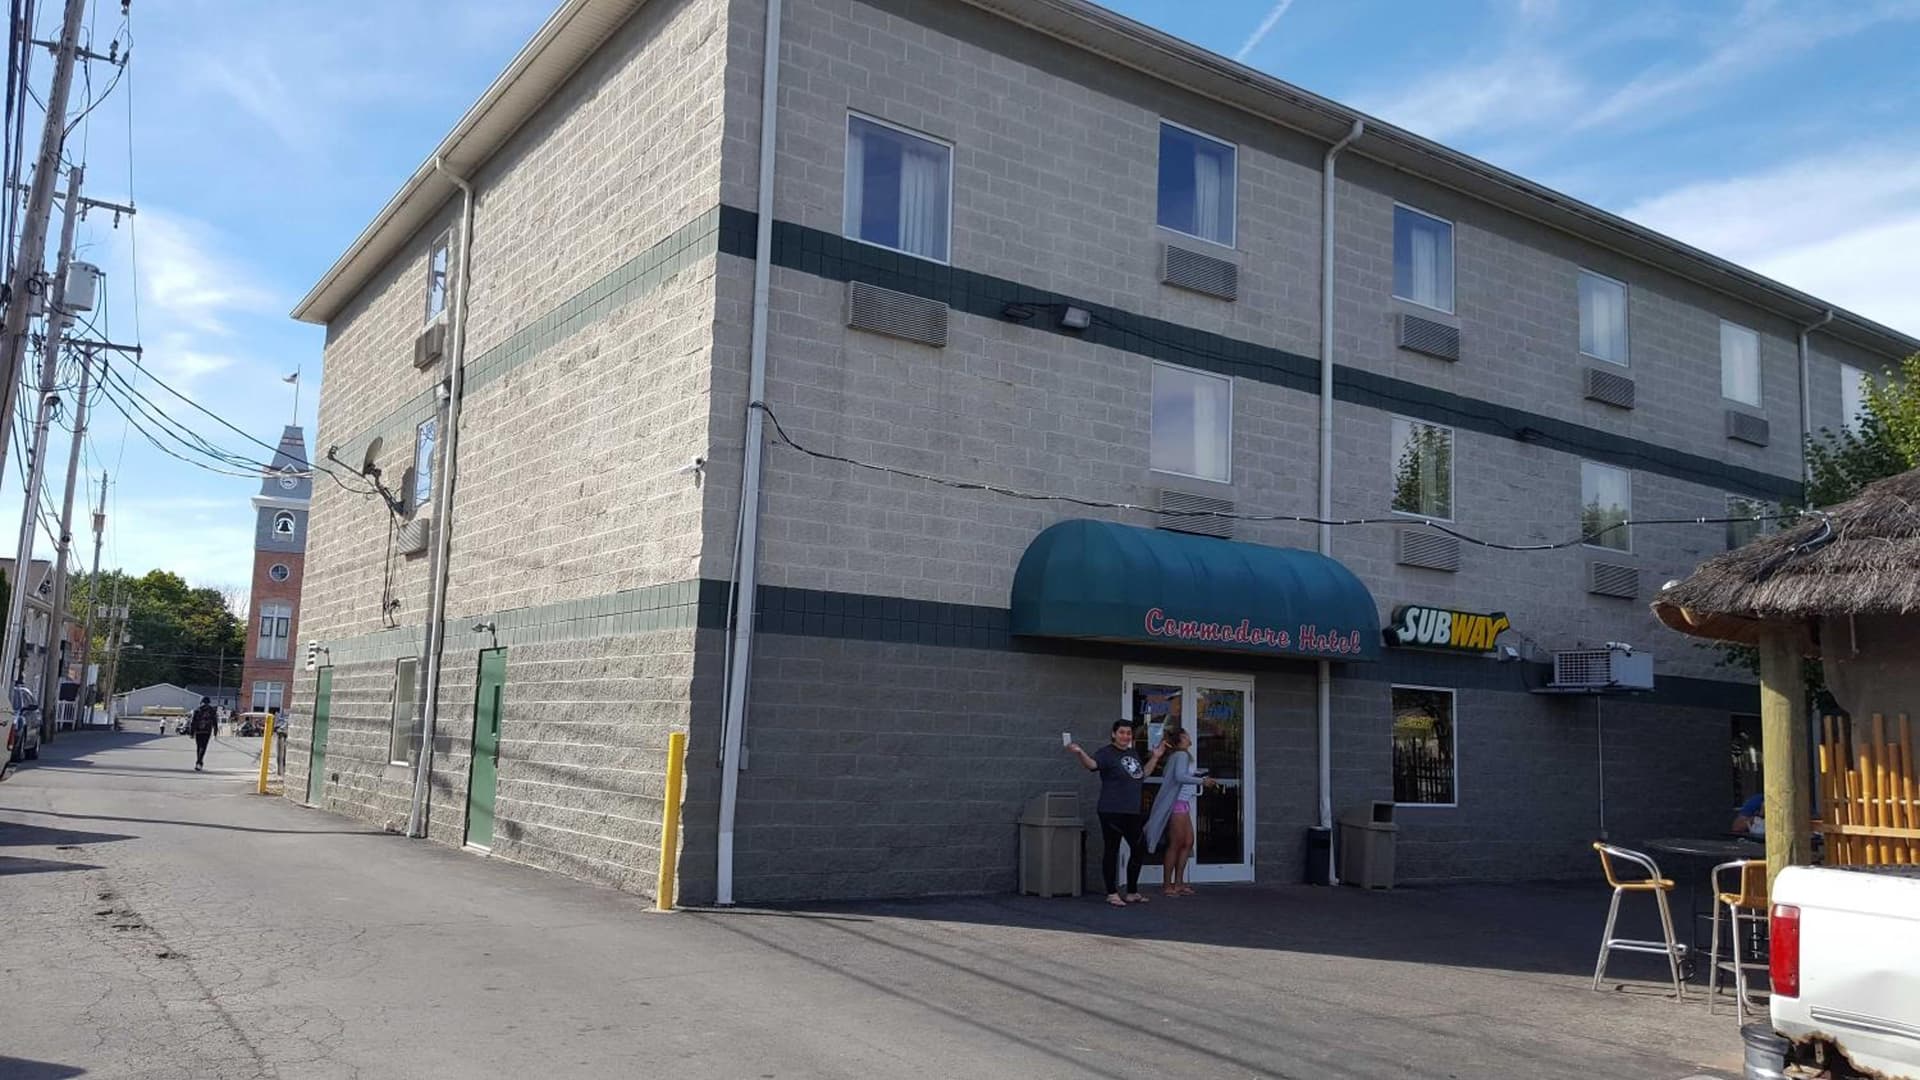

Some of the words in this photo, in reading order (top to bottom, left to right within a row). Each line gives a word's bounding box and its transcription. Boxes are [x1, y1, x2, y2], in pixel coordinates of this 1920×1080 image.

[1145, 607, 1291, 648] Commodore
[1299, 624, 1361, 654] Hotel
[1396, 606, 1509, 649] SUBWAY
